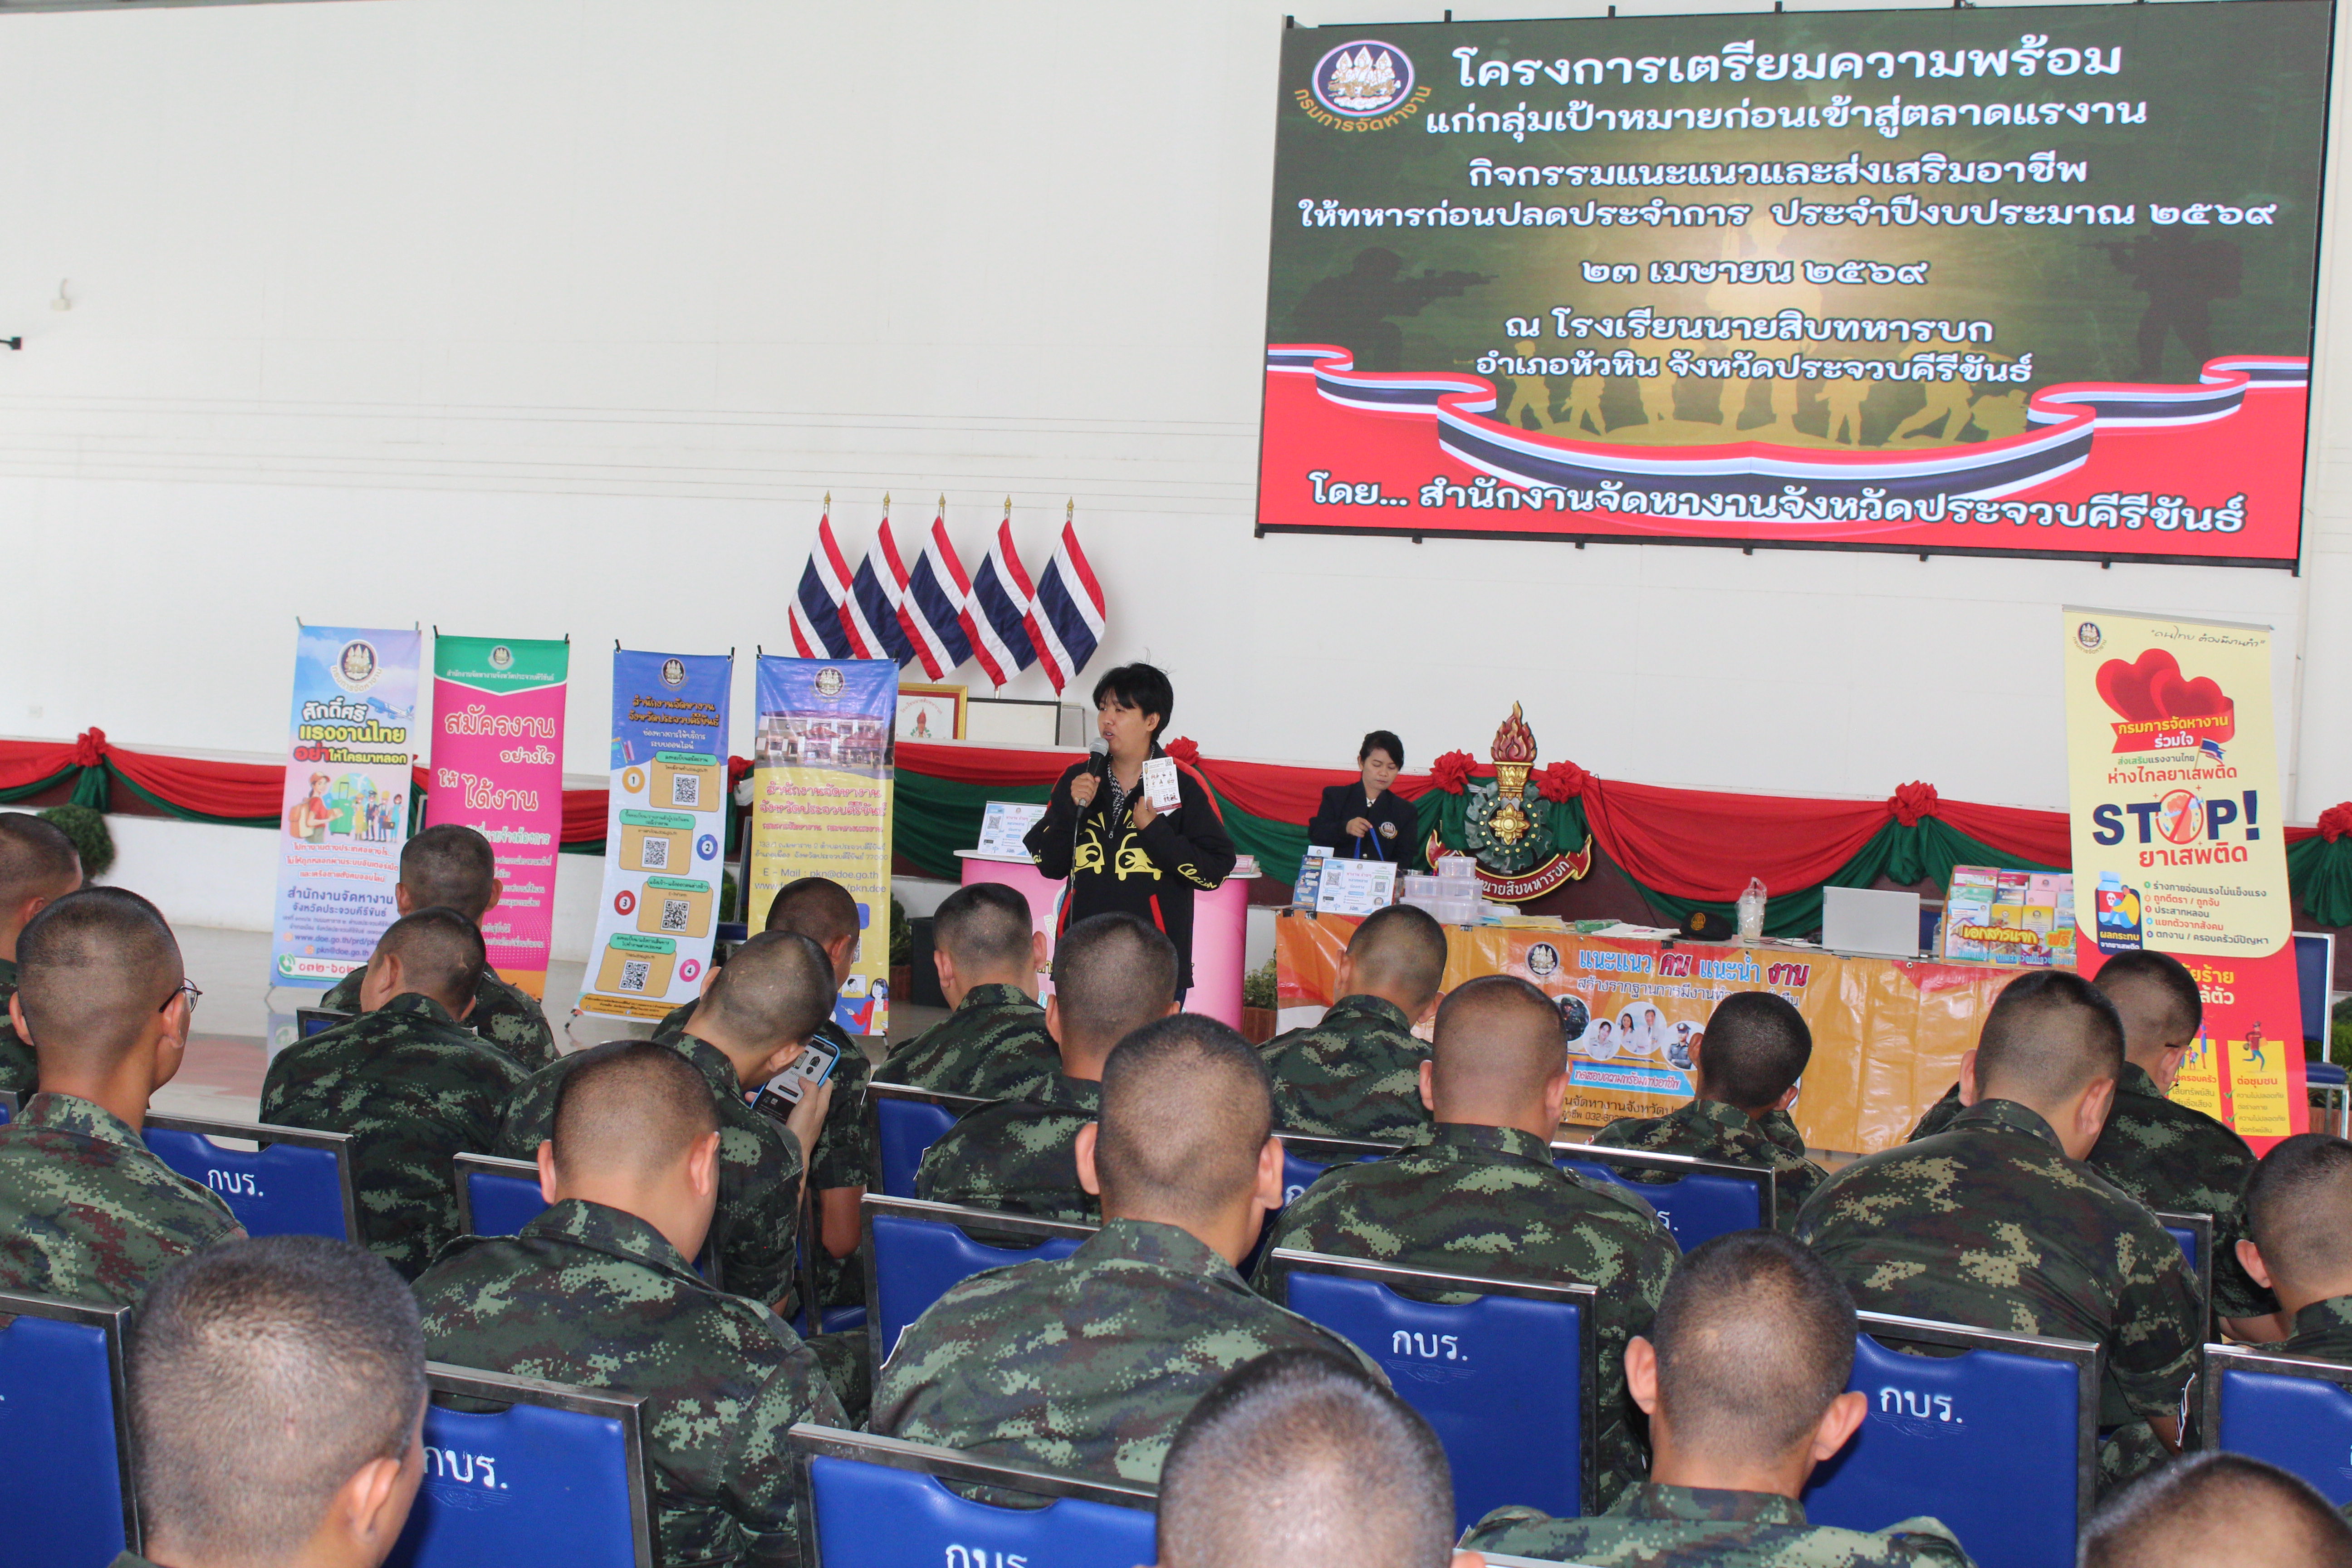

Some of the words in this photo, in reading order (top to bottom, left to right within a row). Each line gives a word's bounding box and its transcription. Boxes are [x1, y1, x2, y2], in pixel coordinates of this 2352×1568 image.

[1452, 34, 2122, 87] โครงการเตรียมความพร้อม
[1294, 85, 1431, 132] กรมการจัดหางาน
[1426, 94, 2147, 143] แก่กลุ่มเป้าหมายก่อนเข้าสู่ตลาดแรงงาน
[1469, 150, 2087, 186] กิจกรรมแนะแนวและส่งเสริมอาชีพ
[1298, 198, 1750, 227] ให้ทหารก่อนปลดประจำการ
[1771, 194, 2135, 226] ประจำปีงบประมาณ
[2149, 203, 2277, 225] ๒๕๖๙
[1582, 261, 1638, 283] ๒๓
[1650, 261, 1793, 283] เมษายน
[1804, 261, 1928, 283] ๒๕๖๙
[1505, 317, 1540, 337] ณ
[1551, 306, 1993, 342] โรงเรียนนายสิบทหารบก
[1476, 350, 1658, 377] อำเภอหัวหิน
[1668, 351, 2034, 382] จังหวัดประจวบคีรีขันธ์
[1309, 473, 1407, 506] โดย...
[1420, 476, 2246, 532] สำนักงานจัดหางานจังหวัดประจวบคีรีขันธ์
[302, 696, 368, 723] ศักดิ์ศรี
[632, 694, 715, 711] สำนักงานจัดหางาน
[445, 704, 555, 738] สมัครงาน
[628, 710, 720, 727] จังหวัดประจวบคีรีขันธ์
[2118, 715, 2229, 734] กรมการจัดหางาน
[299, 719, 406, 743] แรงงานไทย
[643, 728, 706, 740] ช่องทางการให้บริการ
[2154, 731, 2194, 749] ร่วมใจ
[294, 741, 407, 764] อย่าให้ใครมาหลอก
[500, 745, 554, 764] อย่างไร
[2118, 753, 2195, 765] ส่งเสริมแรงงานไทย
[2108, 764, 2237, 784] ห่างไกลยาเสพติด
[438, 768, 458, 788] ให้
[461, 774, 539, 811] ได้งาน
[766, 780, 882, 798] สำนักงานจัดหางาน
[759, 799, 887, 816] จังหวัดประจวบคีรีขันธ์
[2092, 790, 2260, 846] STOP!
[705, 843, 710, 852] 2
[2139, 842, 2248, 867] ยาเสพติด
[810, 869, 878, 880] pkn@doe.go.th
[1477, 861, 1570, 896] นายสิบทหารบก
[288, 886, 393, 904] สำนักงานจัดหางาน
[2153, 881, 2266, 897] ร่างกายอ่อนแรงไม่แข็งแรง
[293, 902, 387, 917] จังหวัดประจวบคีรีขันธ์
[622, 899, 627, 907] 3
[2155, 906, 2210, 917] ประสาทหลอน
[2196, 898, 2220, 908] ถูกจับ
[2155, 917, 2224, 931] แยกตัวจากสังคม
[1964, 926, 2039, 945] เอกสารแจก
[2046, 928, 2075, 948] ฟรี
[2100, 931, 2140, 941] ผลกระทบ
[2156, 931, 2184, 940] ตกงาน
[2194, 934, 2269, 945] ครอบครัวมีปัญหา
[299, 963, 358, 974] ๐๓๒-๖๐๒
[1578, 949, 1652, 974] แนะแนว
[1659, 951, 1692, 978] คน
[1700, 953, 1760, 983] แนะนำ
[1769, 961, 1810, 988] งาน
[2182, 962, 2234, 984] ัยร้าย
[2200, 985, 2234, 1004] ล้ตัว
[2175, 1074, 2216, 1083] อครอบครัว
[2237, 1077, 2278, 1089] ต่อชุมชน
[208, 1167, 265, 1197] กบร.
[1392, 1329, 1468, 1362] กบร.
[1879, 1386, 1964, 1424] กบร.
[424, 1446, 508, 1490] กบร.
